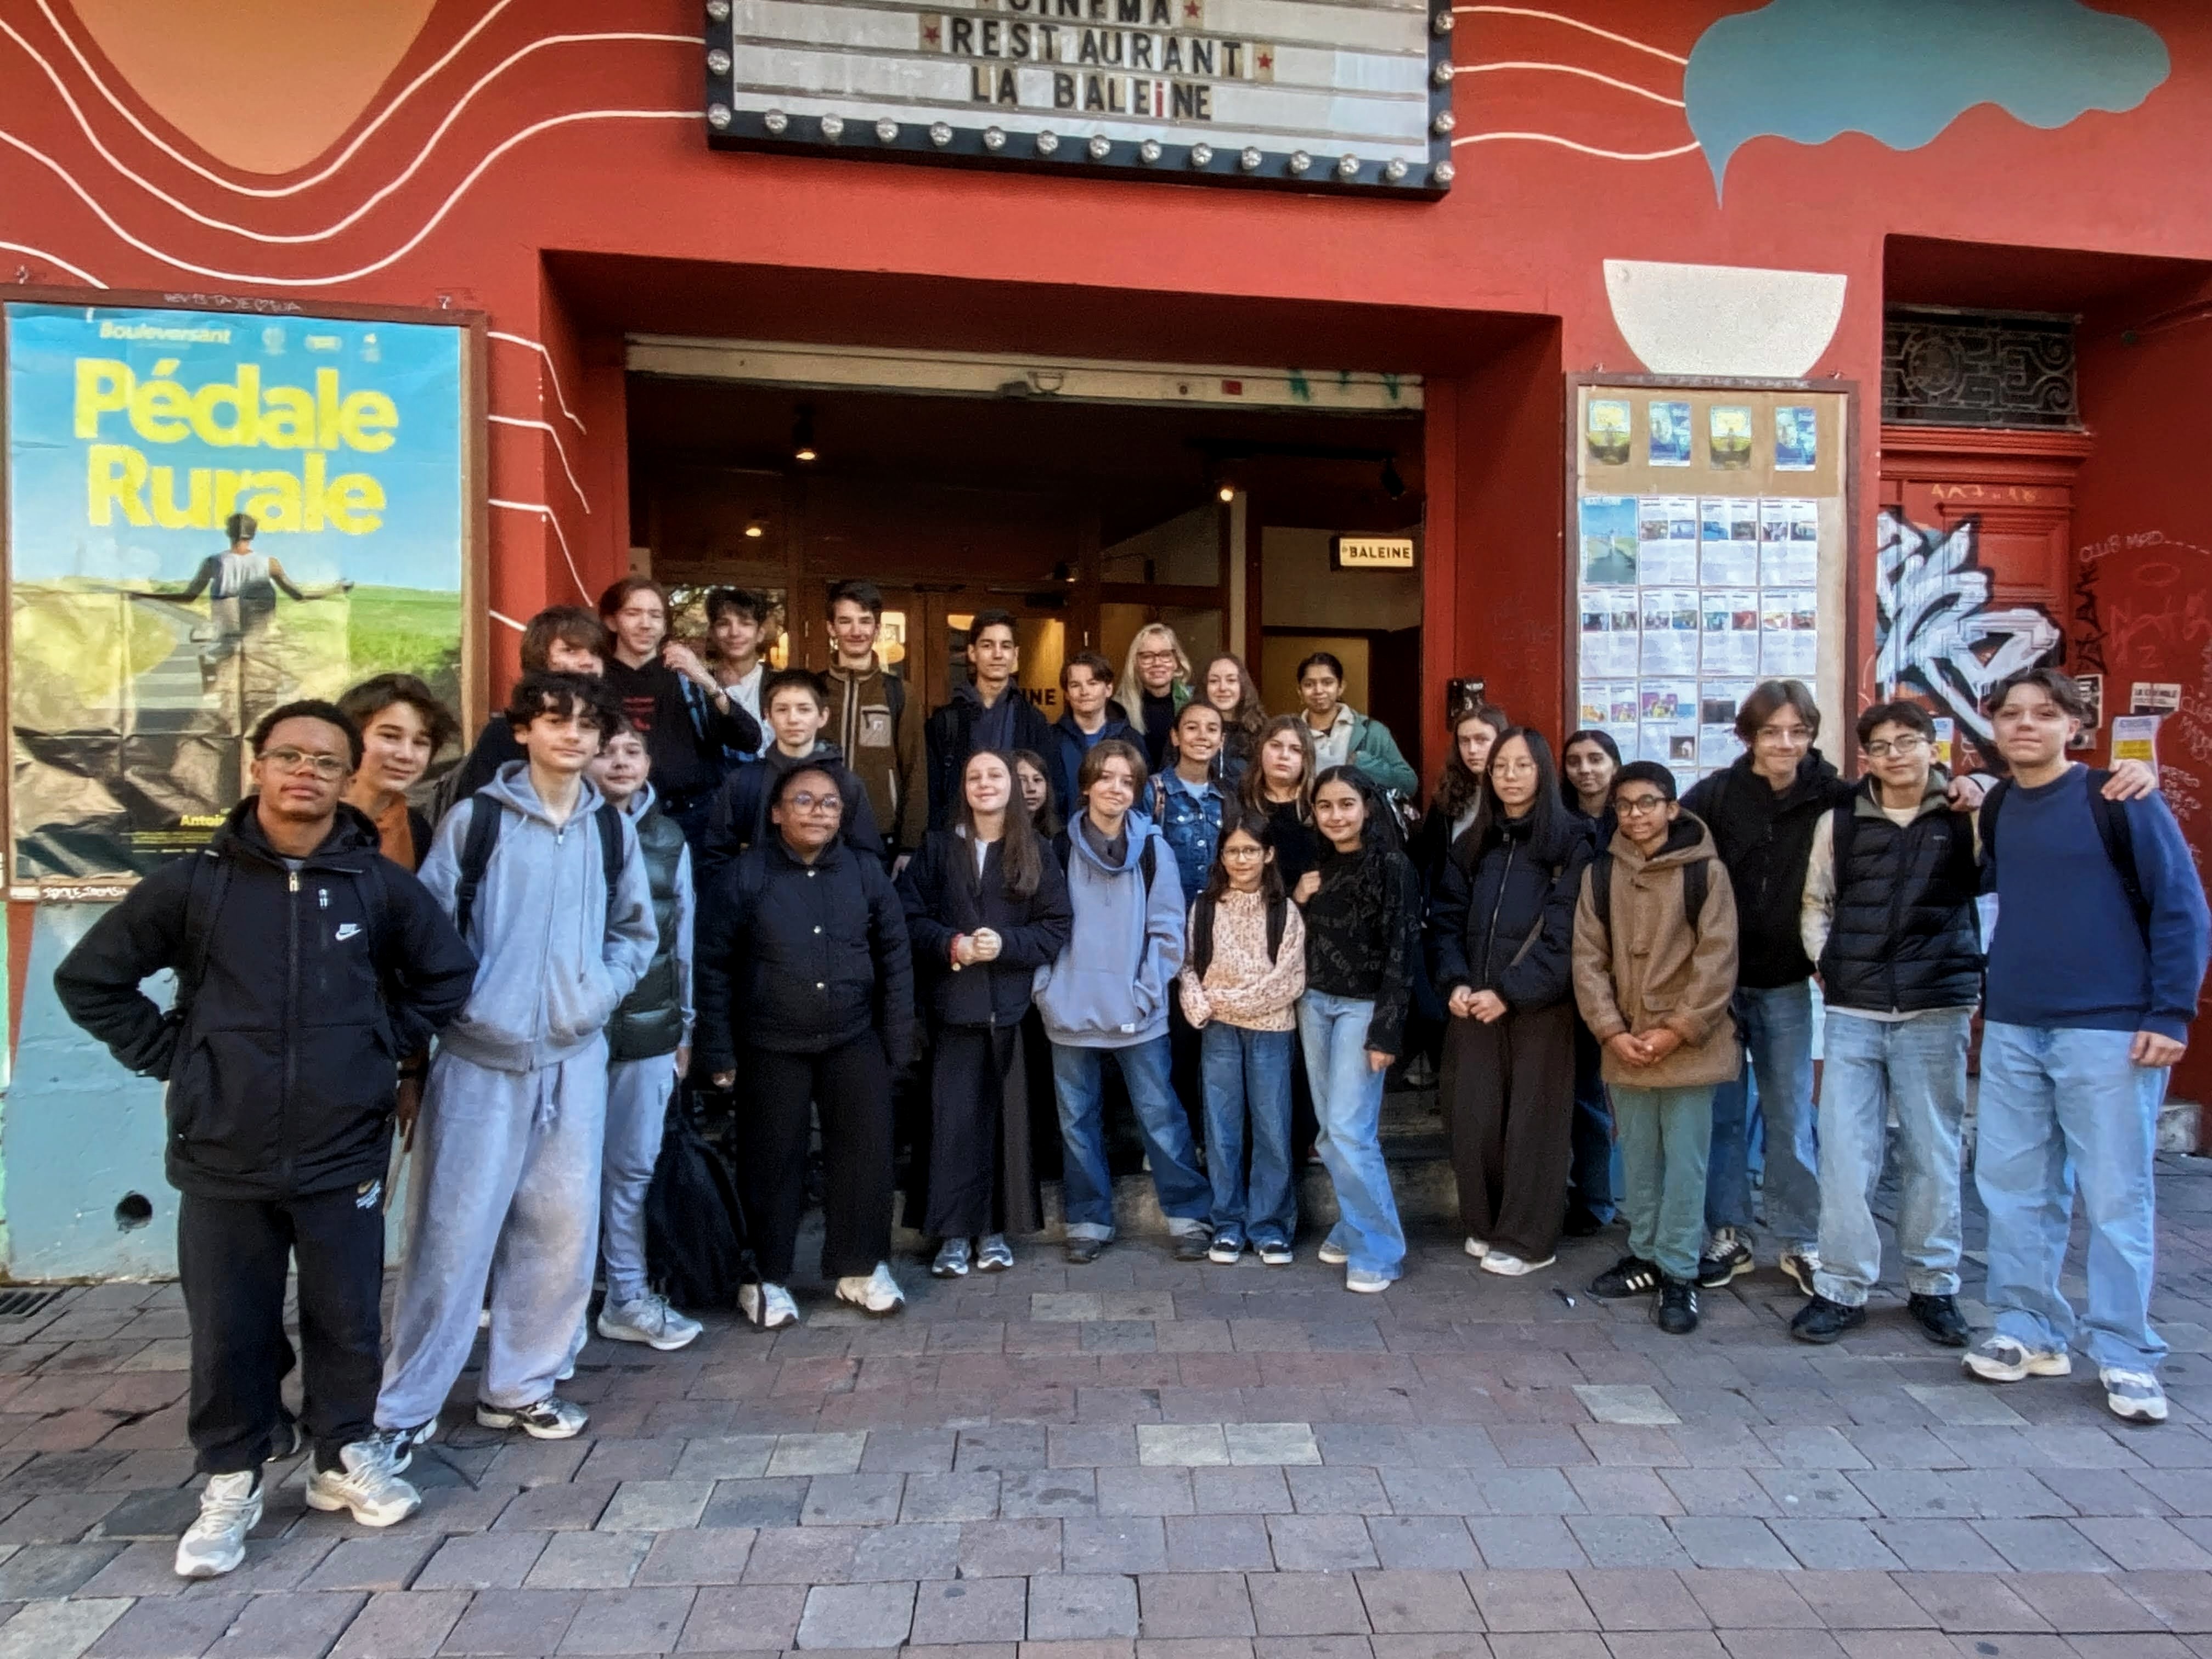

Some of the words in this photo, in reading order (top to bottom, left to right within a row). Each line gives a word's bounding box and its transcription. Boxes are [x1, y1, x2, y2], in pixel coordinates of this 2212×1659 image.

[951, 17, 1241, 76] RESTAURANT
[972, 67, 1018, 104] LA
[74, 358, 399, 453] Pédale
[87, 444, 386, 535] Rurale
[1349, 545, 1410, 559] BALEINE
